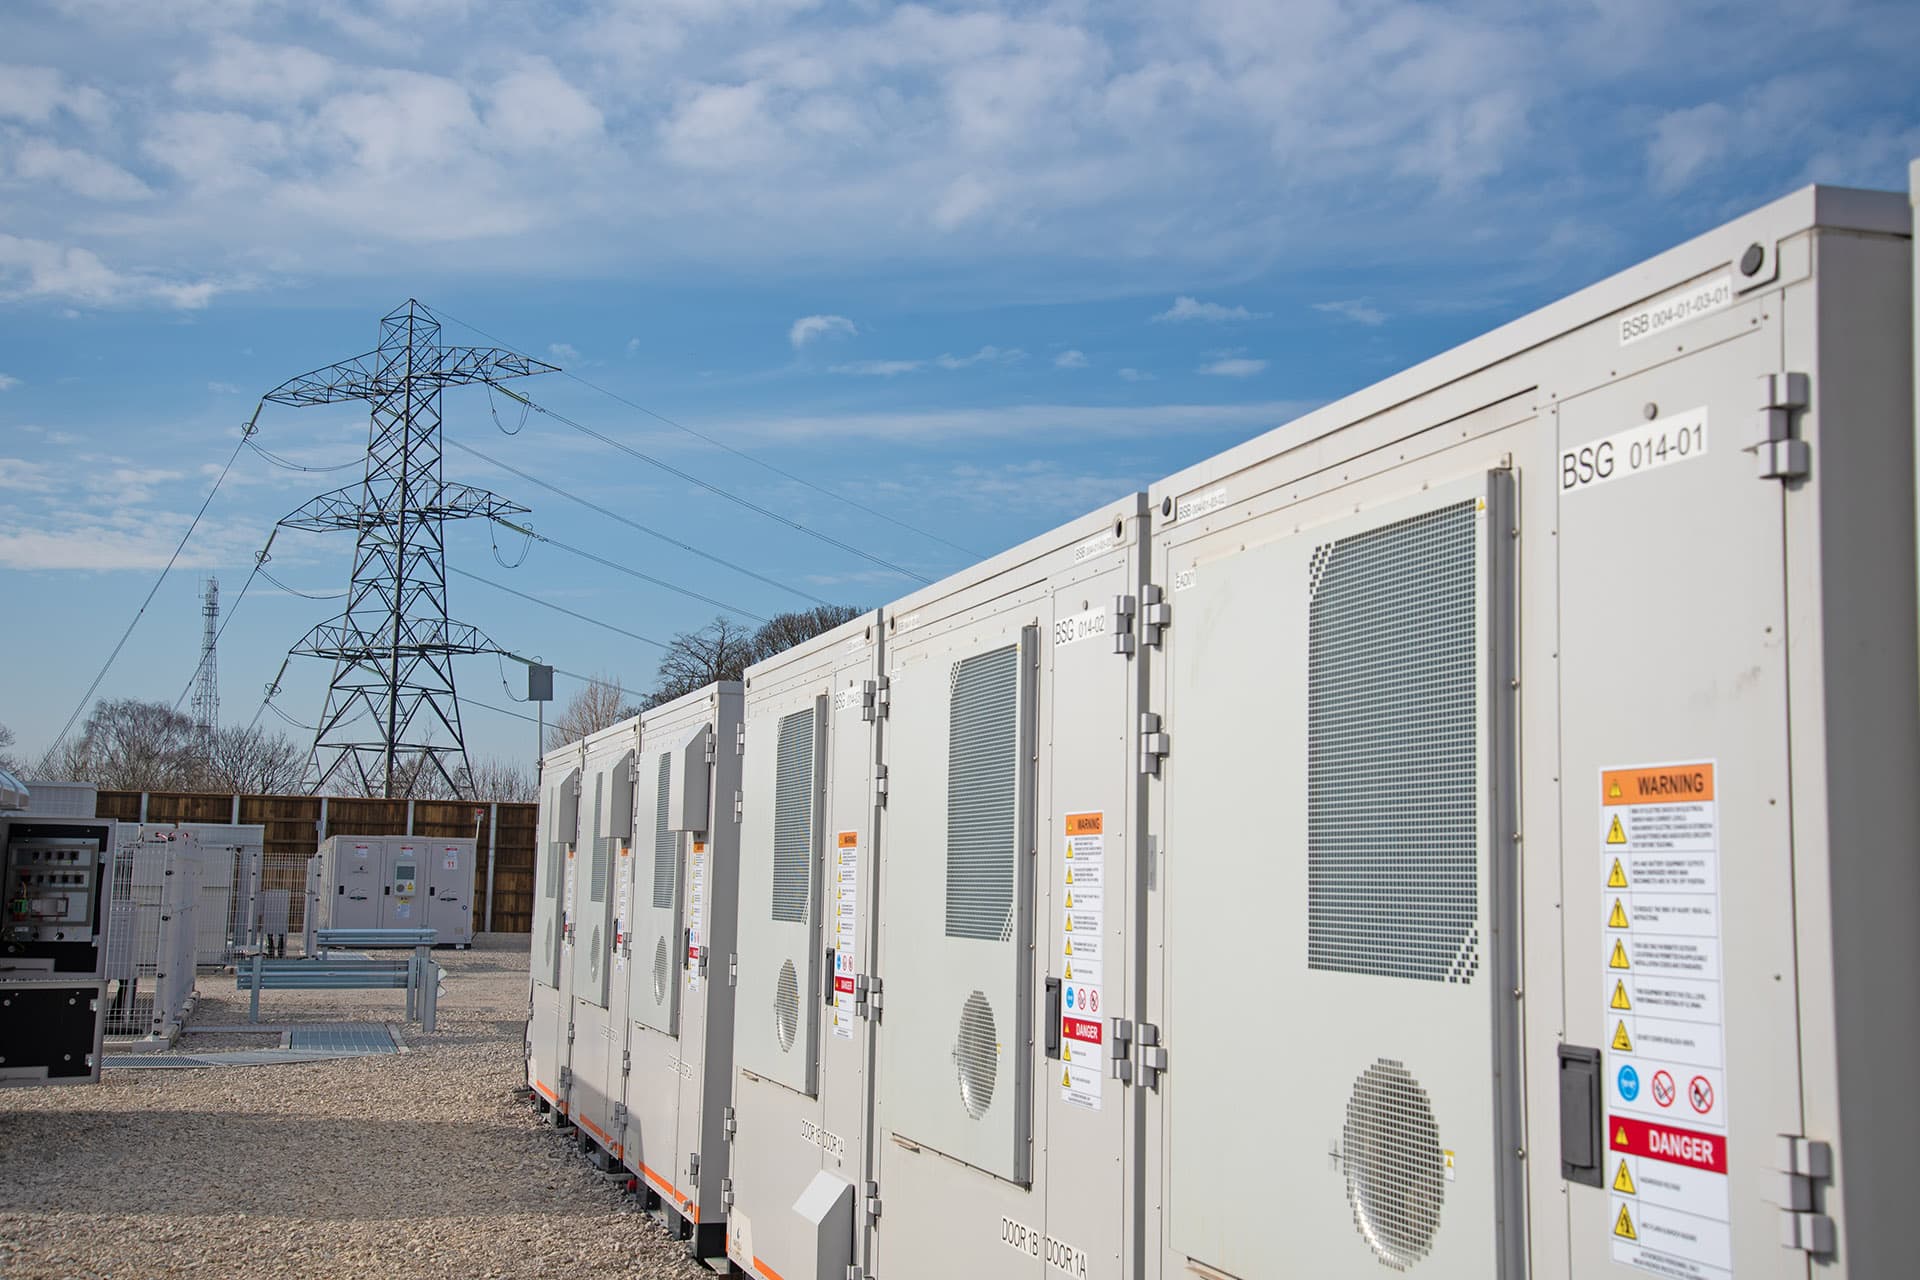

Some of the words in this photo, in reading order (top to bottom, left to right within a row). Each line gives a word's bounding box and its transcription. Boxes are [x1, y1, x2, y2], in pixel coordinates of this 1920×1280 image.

[1622, 314, 1650, 341] BSB
[1652, 285, 1729, 329] 004-01-03-01
[1563, 441, 1614, 490] BSG
[1630, 423, 1703, 469] 014-01
[1056, 618, 1074, 645] BSG
[1079, 615, 1105, 638] 014-02
[1637, 772, 1704, 796] WARNING
[1077, 817, 1100, 831] WARNING
[1075, 1023, 1098, 1039] DANGER
[802, 1120, 816, 1142] DOOR
[823, 1131, 837, 1154] DOOR
[1648, 1129, 1714, 1164] DANGER
[1002, 1217, 1026, 1251] DOOR
[1028, 1231, 1038, 1256] 1B
[1047, 1237, 1072, 1273] DOOR
[1075, 1252, 1086, 1280] 1A
